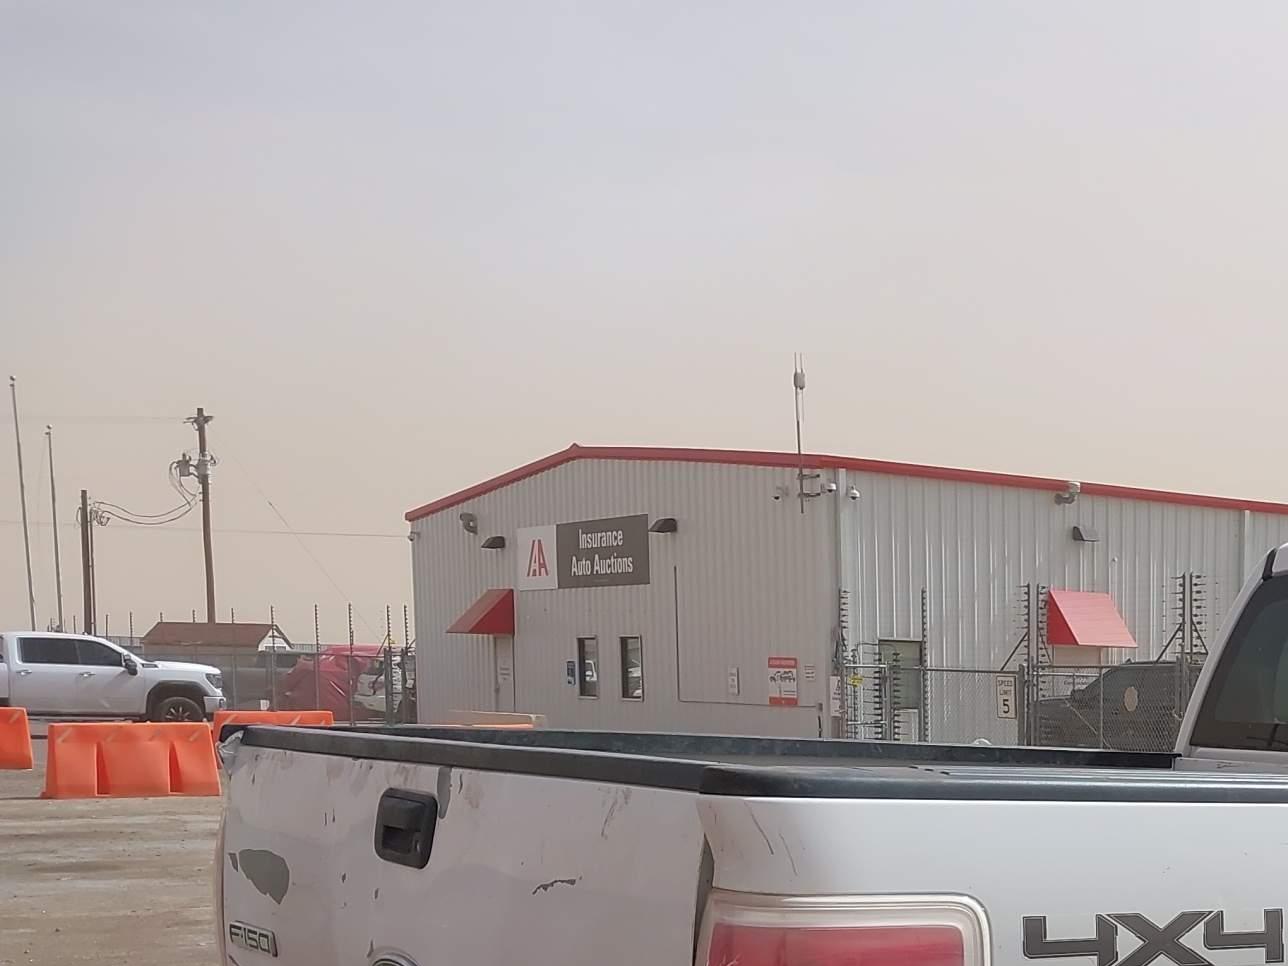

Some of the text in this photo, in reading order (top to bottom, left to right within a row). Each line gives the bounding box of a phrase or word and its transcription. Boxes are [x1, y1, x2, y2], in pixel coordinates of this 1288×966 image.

[578, 528, 623, 549] Insurance
[571, 551, 633, 577] Auto Auctions
[1002, 698, 1010, 714] 5
